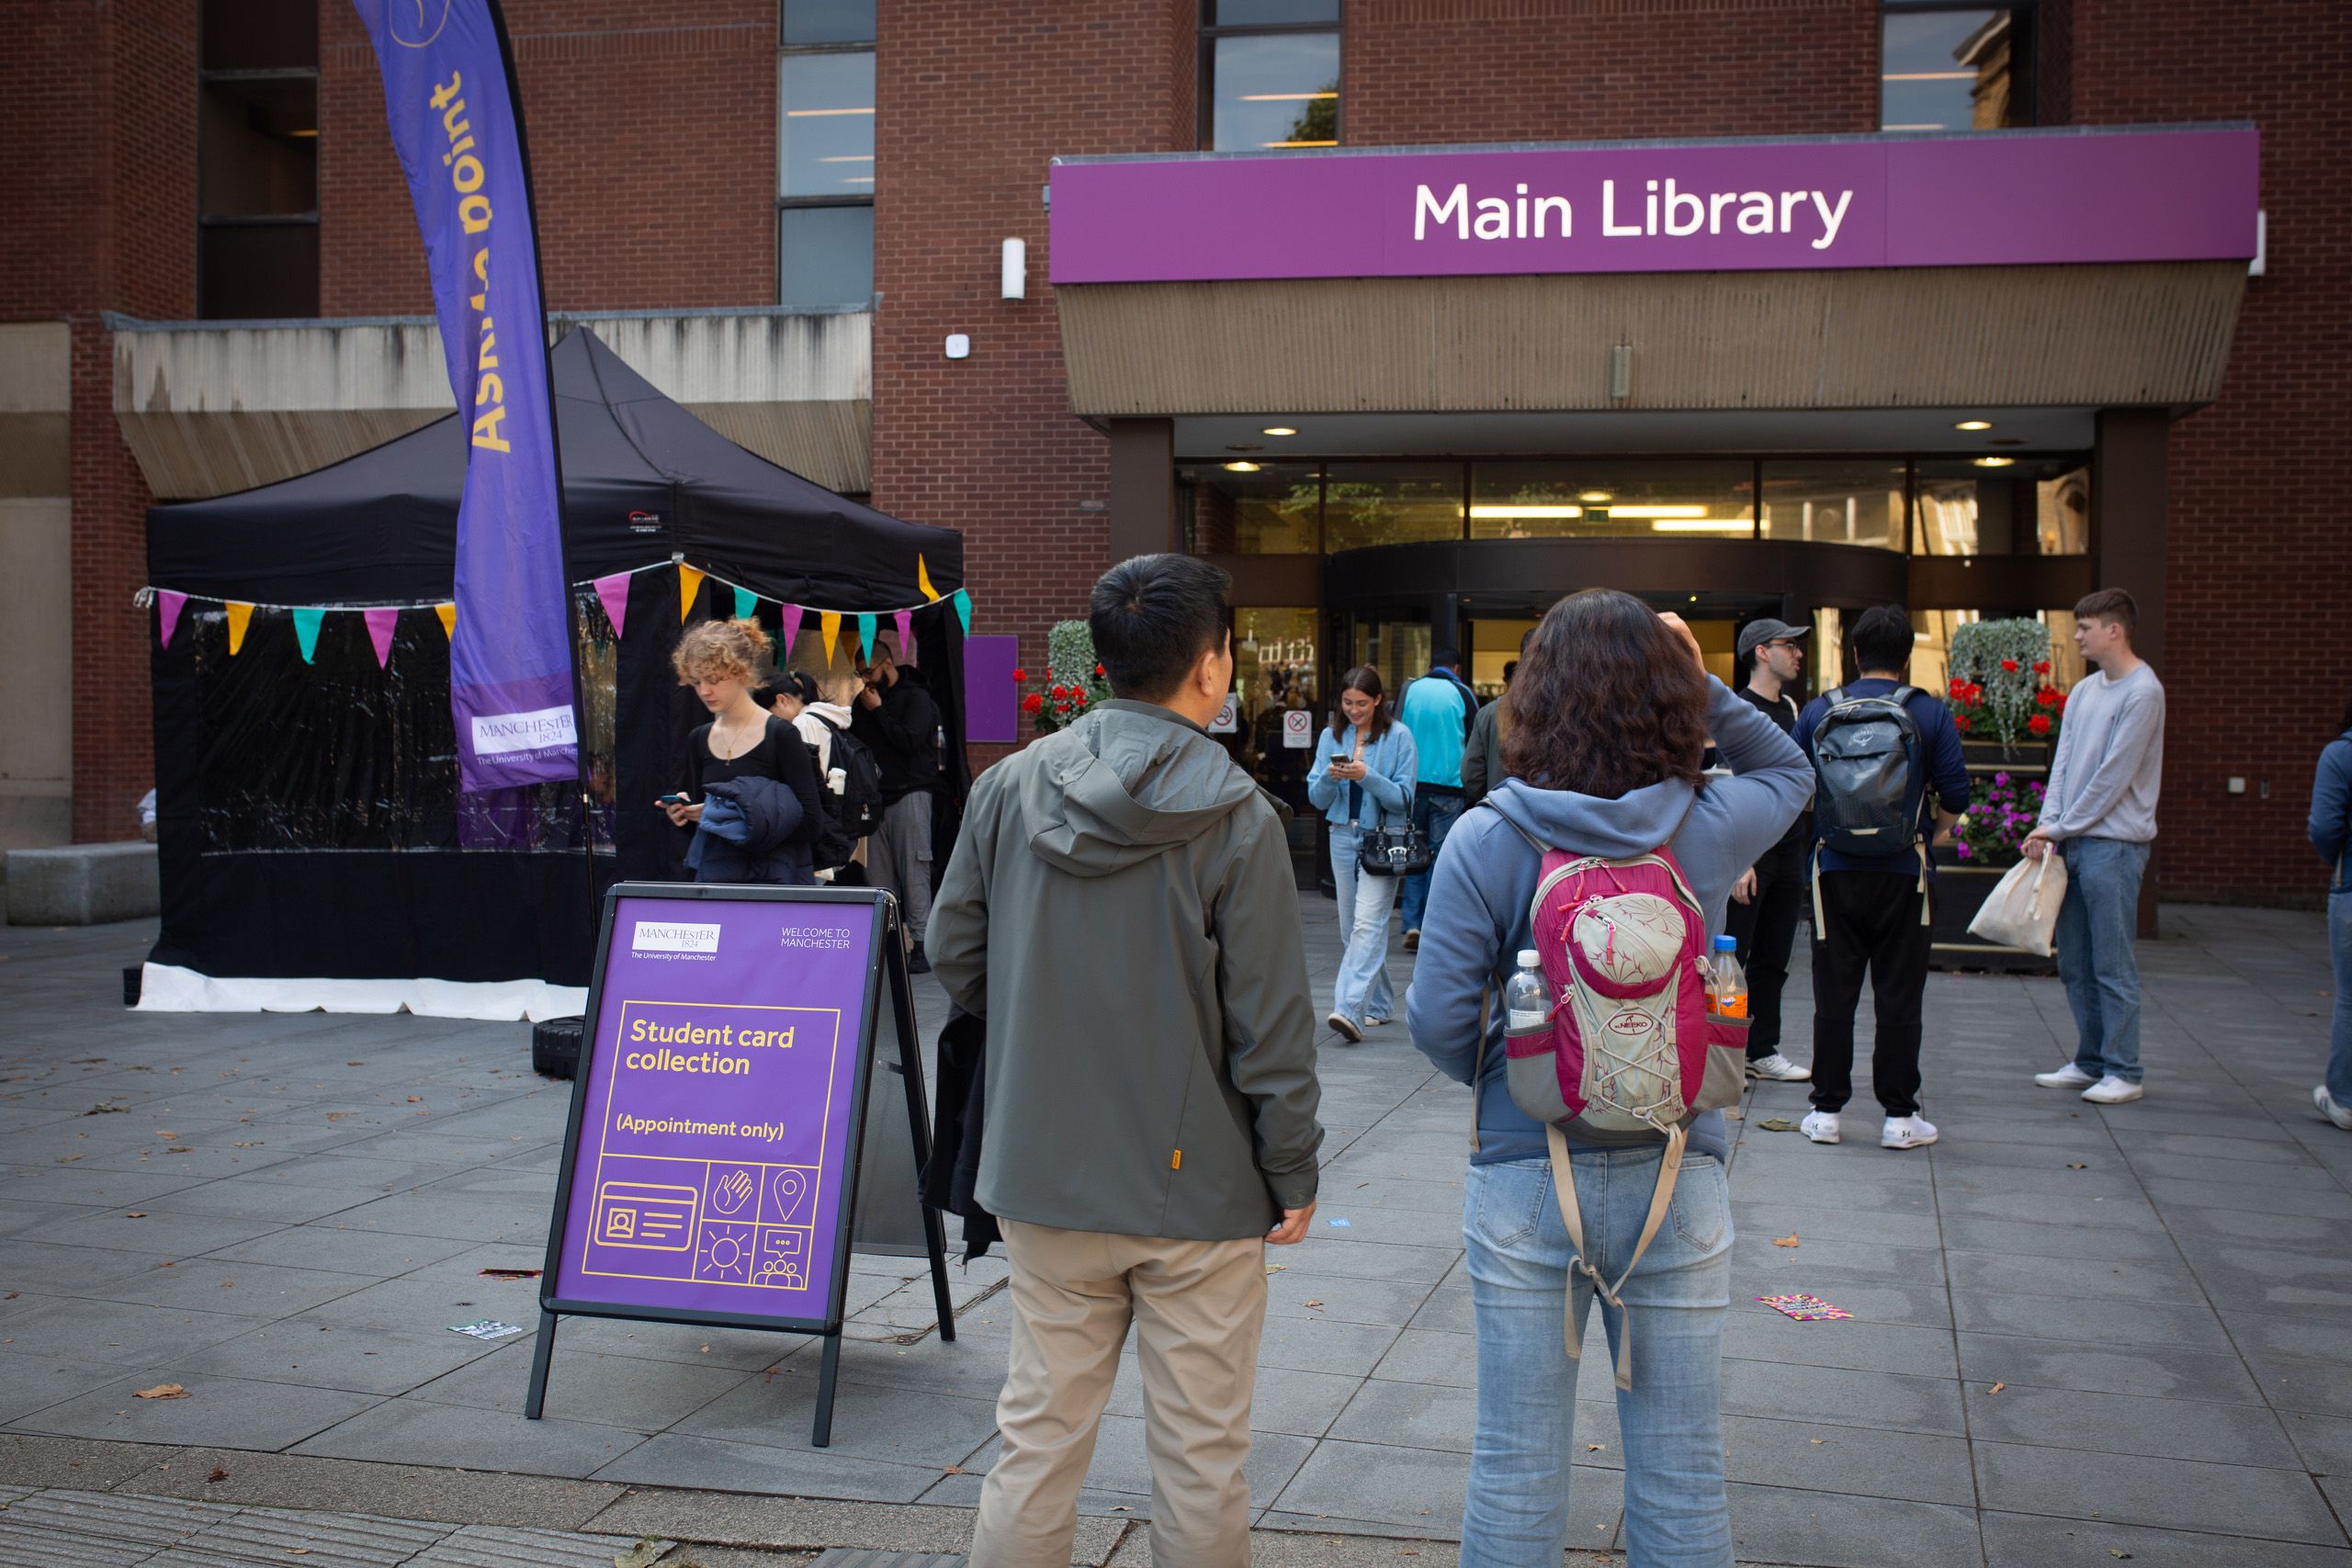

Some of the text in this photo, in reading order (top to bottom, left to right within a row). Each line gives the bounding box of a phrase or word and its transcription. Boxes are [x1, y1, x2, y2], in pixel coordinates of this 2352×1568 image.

[1415, 178, 1853, 250] Main Library
[480, 715, 573, 738] MANCHESTER
[538, 730, 562, 743] 1824
[478, 755, 492, 765] The
[492, 750, 534, 763] University
[639, 928, 716, 941] MANCHESTER
[782, 927, 850, 938] WELCOME TO
[681, 940, 698, 948] 1824
[781, 938, 850, 949] MANCHESTER
[631, 951, 643, 959] The
[643, 952, 673, 962] University
[681, 953, 717, 962] Manchester
[630, 1019, 795, 1048] Student card
[626, 1048, 750, 1075] collection
[616, 1112, 784, 1143] (Appointment only)
